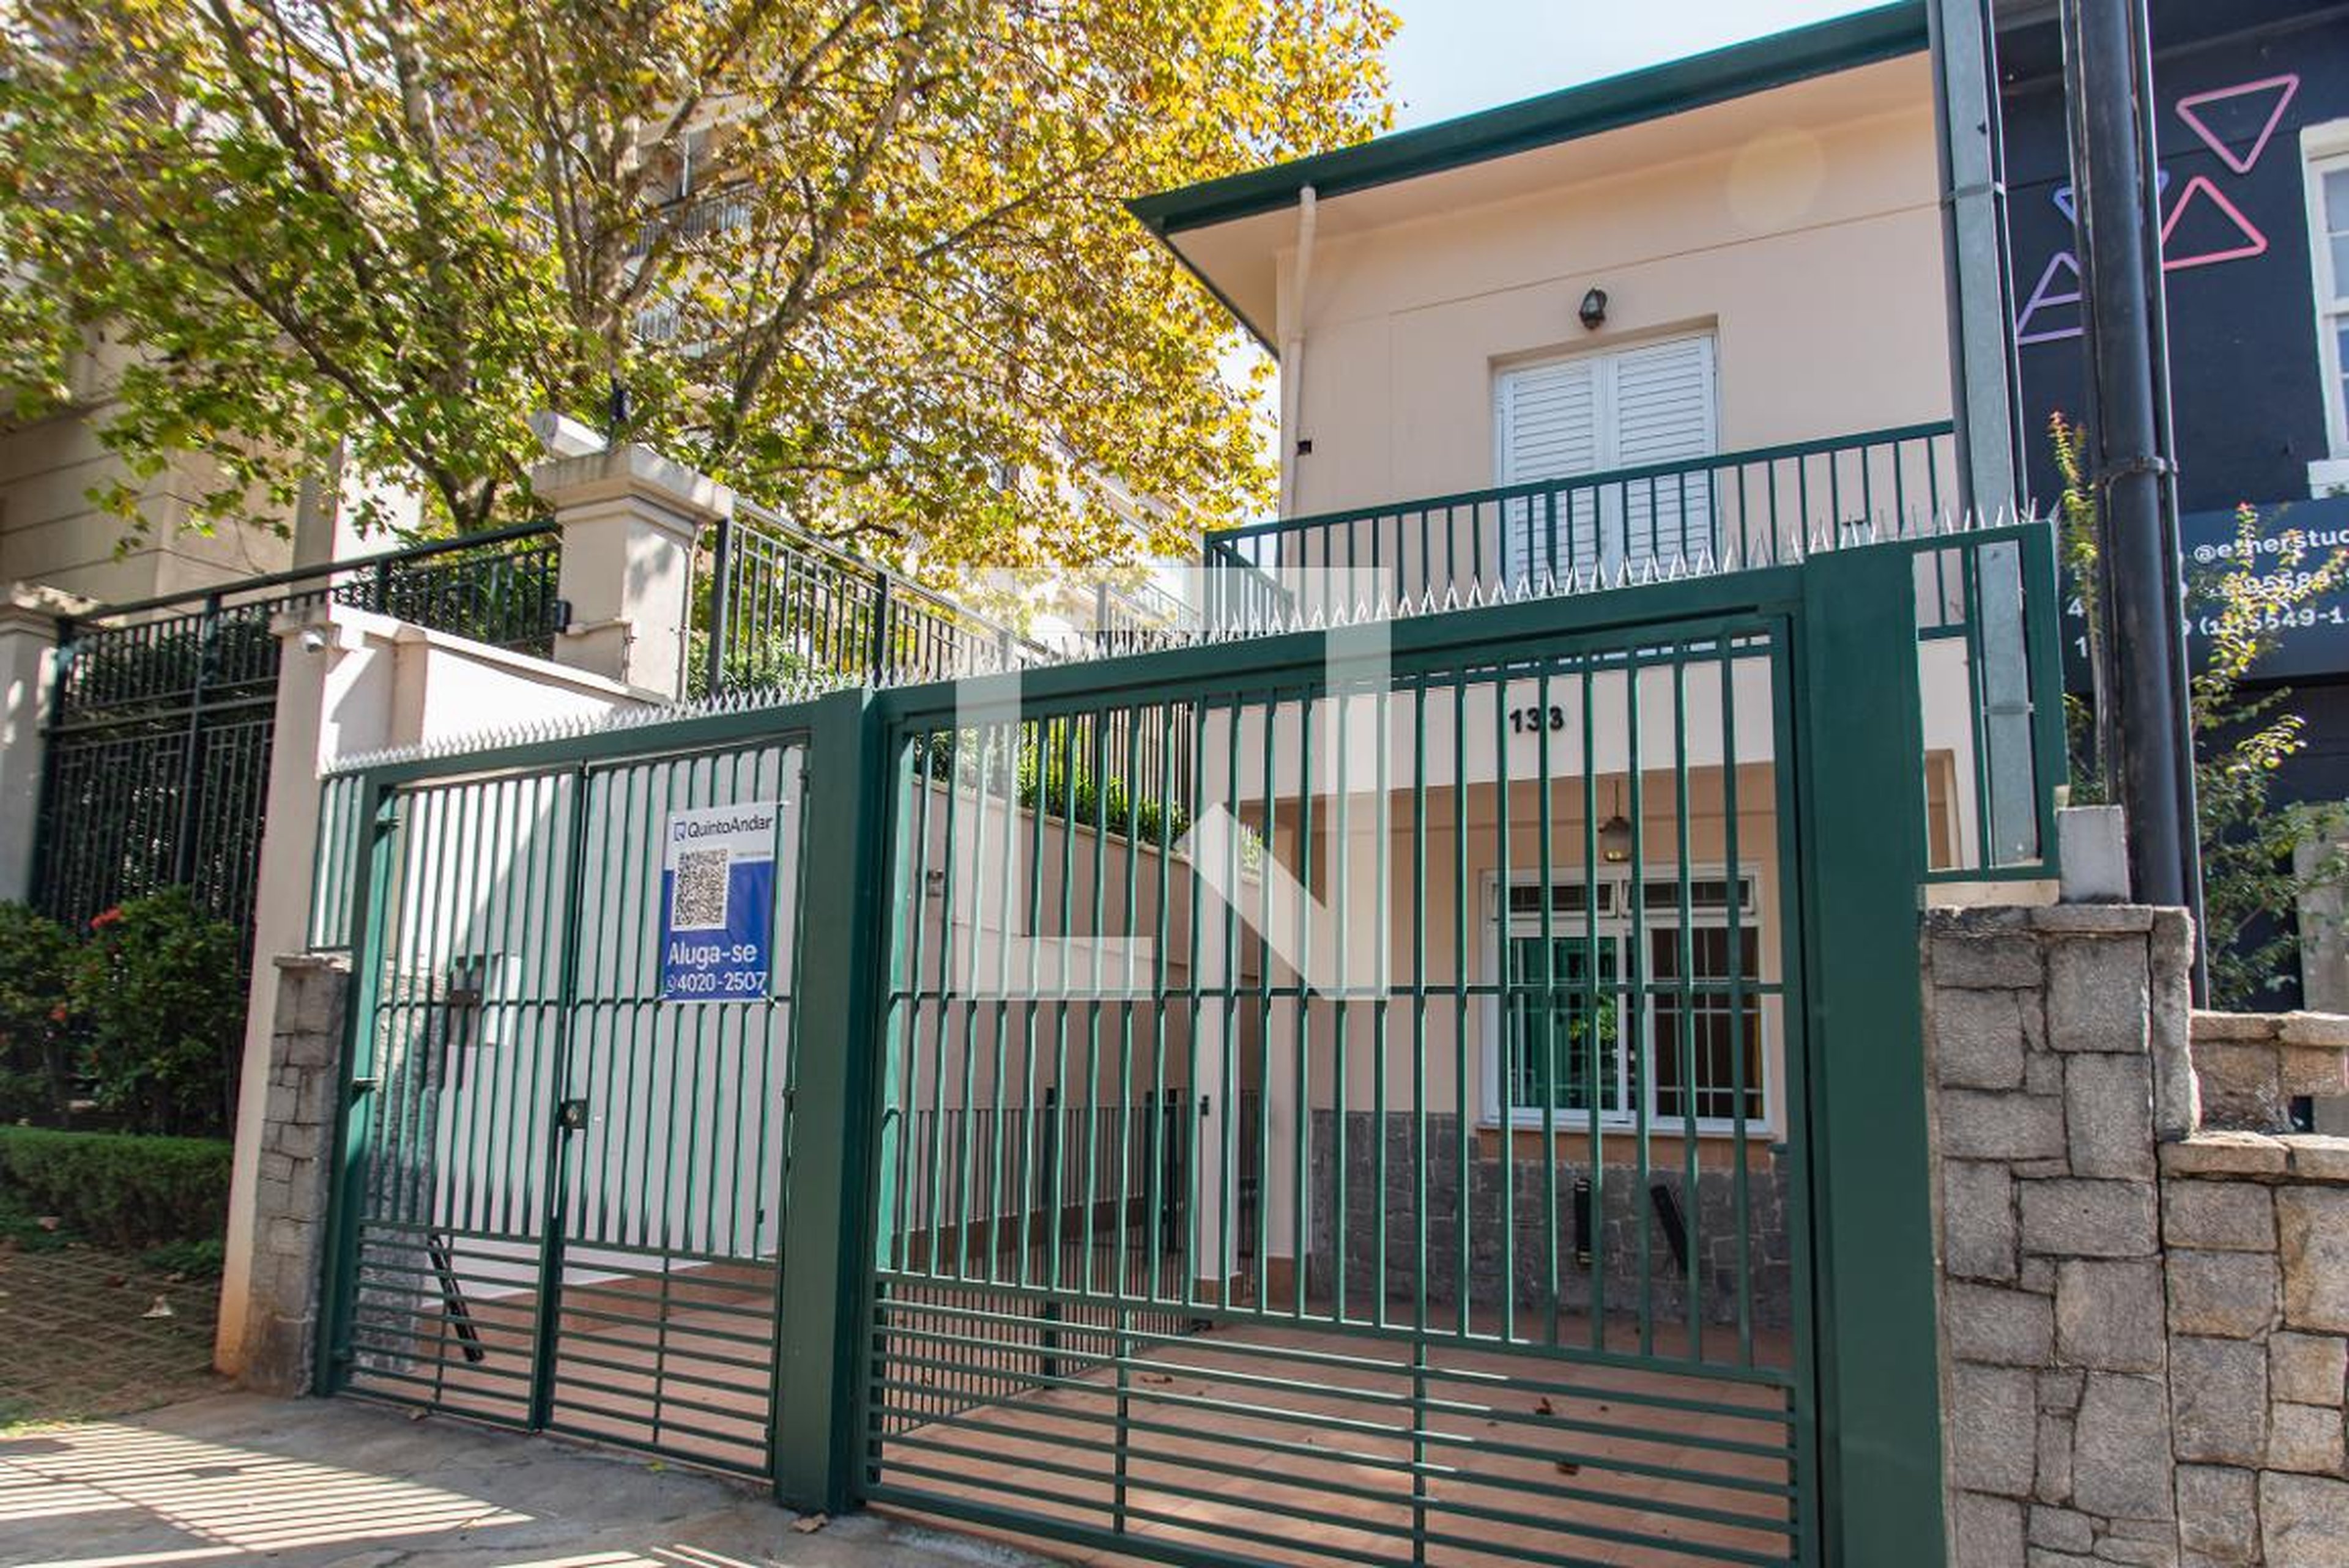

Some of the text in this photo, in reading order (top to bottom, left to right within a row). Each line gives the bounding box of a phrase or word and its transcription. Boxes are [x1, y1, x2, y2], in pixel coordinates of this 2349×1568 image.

[1509, 705, 1564, 733] 133
[688, 814, 773, 838] QuintoAndar
[667, 941, 758, 971] Aluga-se
[677, 971, 767, 992] 4020-2507
